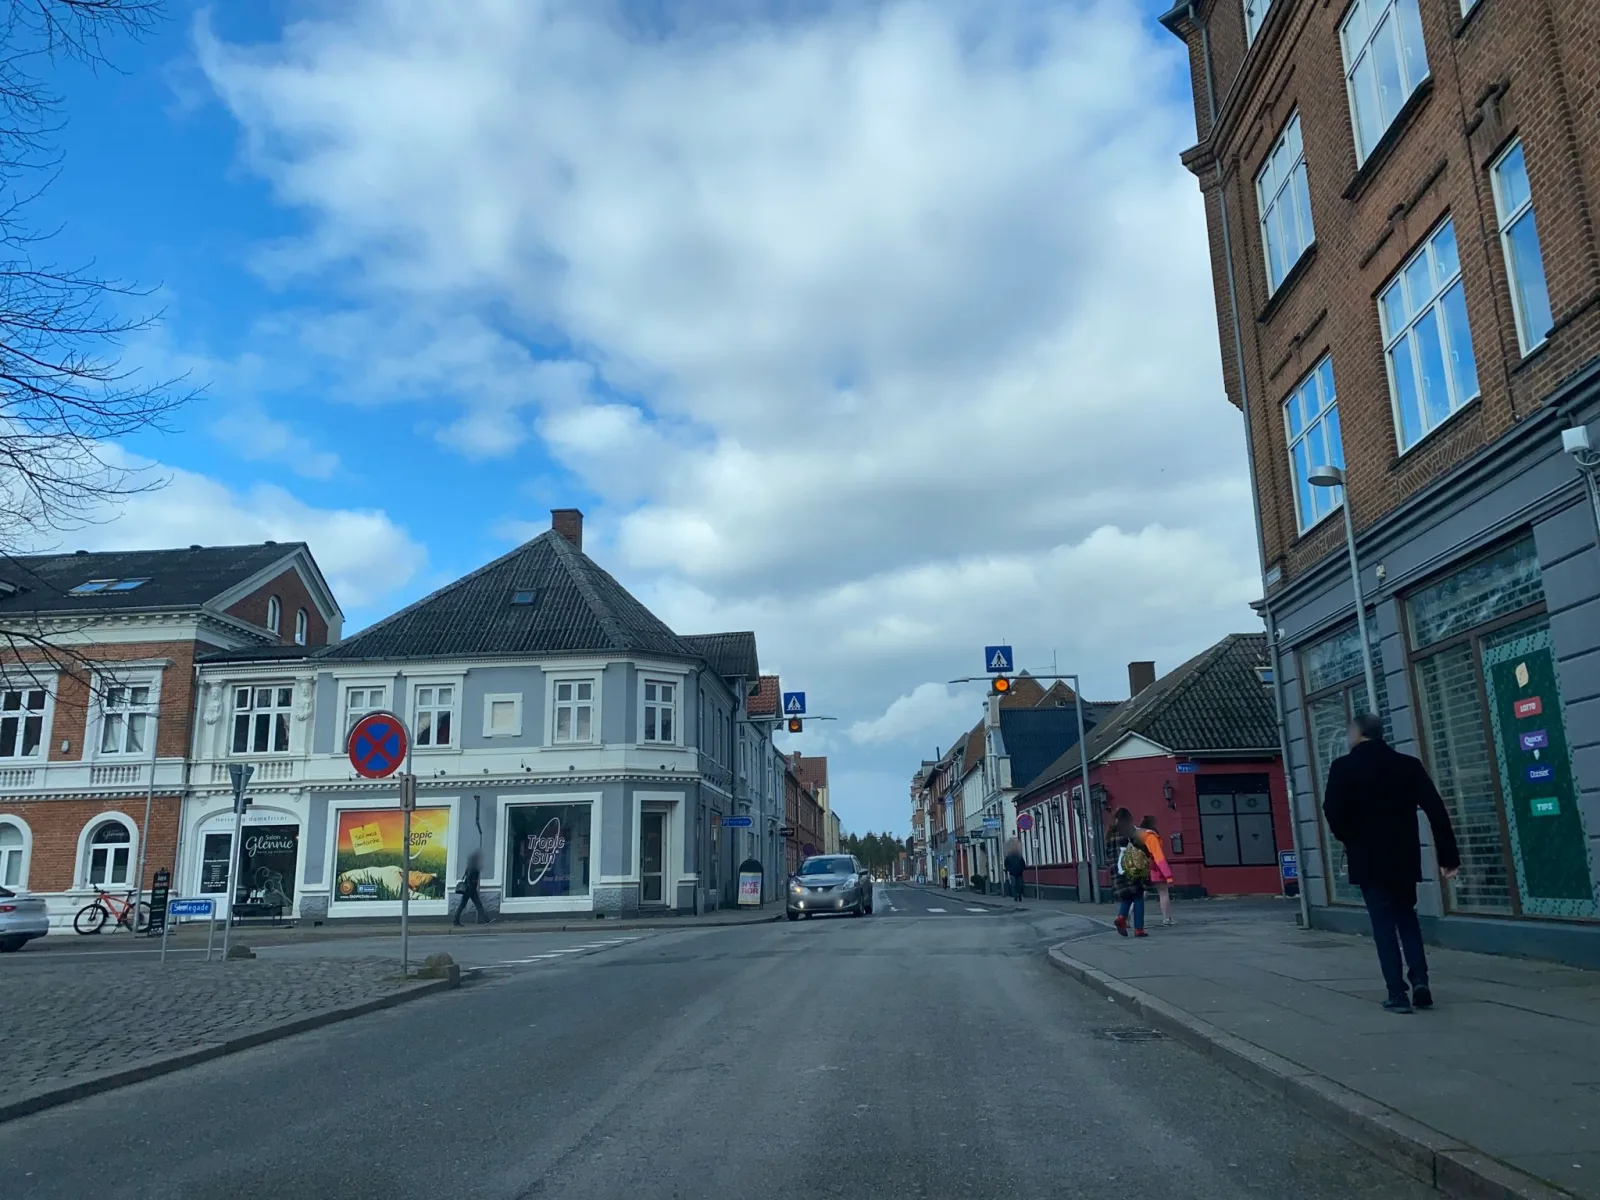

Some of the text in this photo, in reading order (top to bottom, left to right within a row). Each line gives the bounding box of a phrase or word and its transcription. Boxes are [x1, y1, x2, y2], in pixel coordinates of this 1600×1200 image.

[1520, 702, 1536, 713] LOTTO
[1537, 802, 1554, 812] TIPS
[410, 830, 433, 841] ropic
[245, 836, 294, 858] Glennie
[410, 837, 427, 846] Sun
[528, 835, 565, 853] Tropic
[532, 850, 556, 865] Sun
[742, 881, 759, 889] NYE
[173, 904, 209, 913] Slegade
